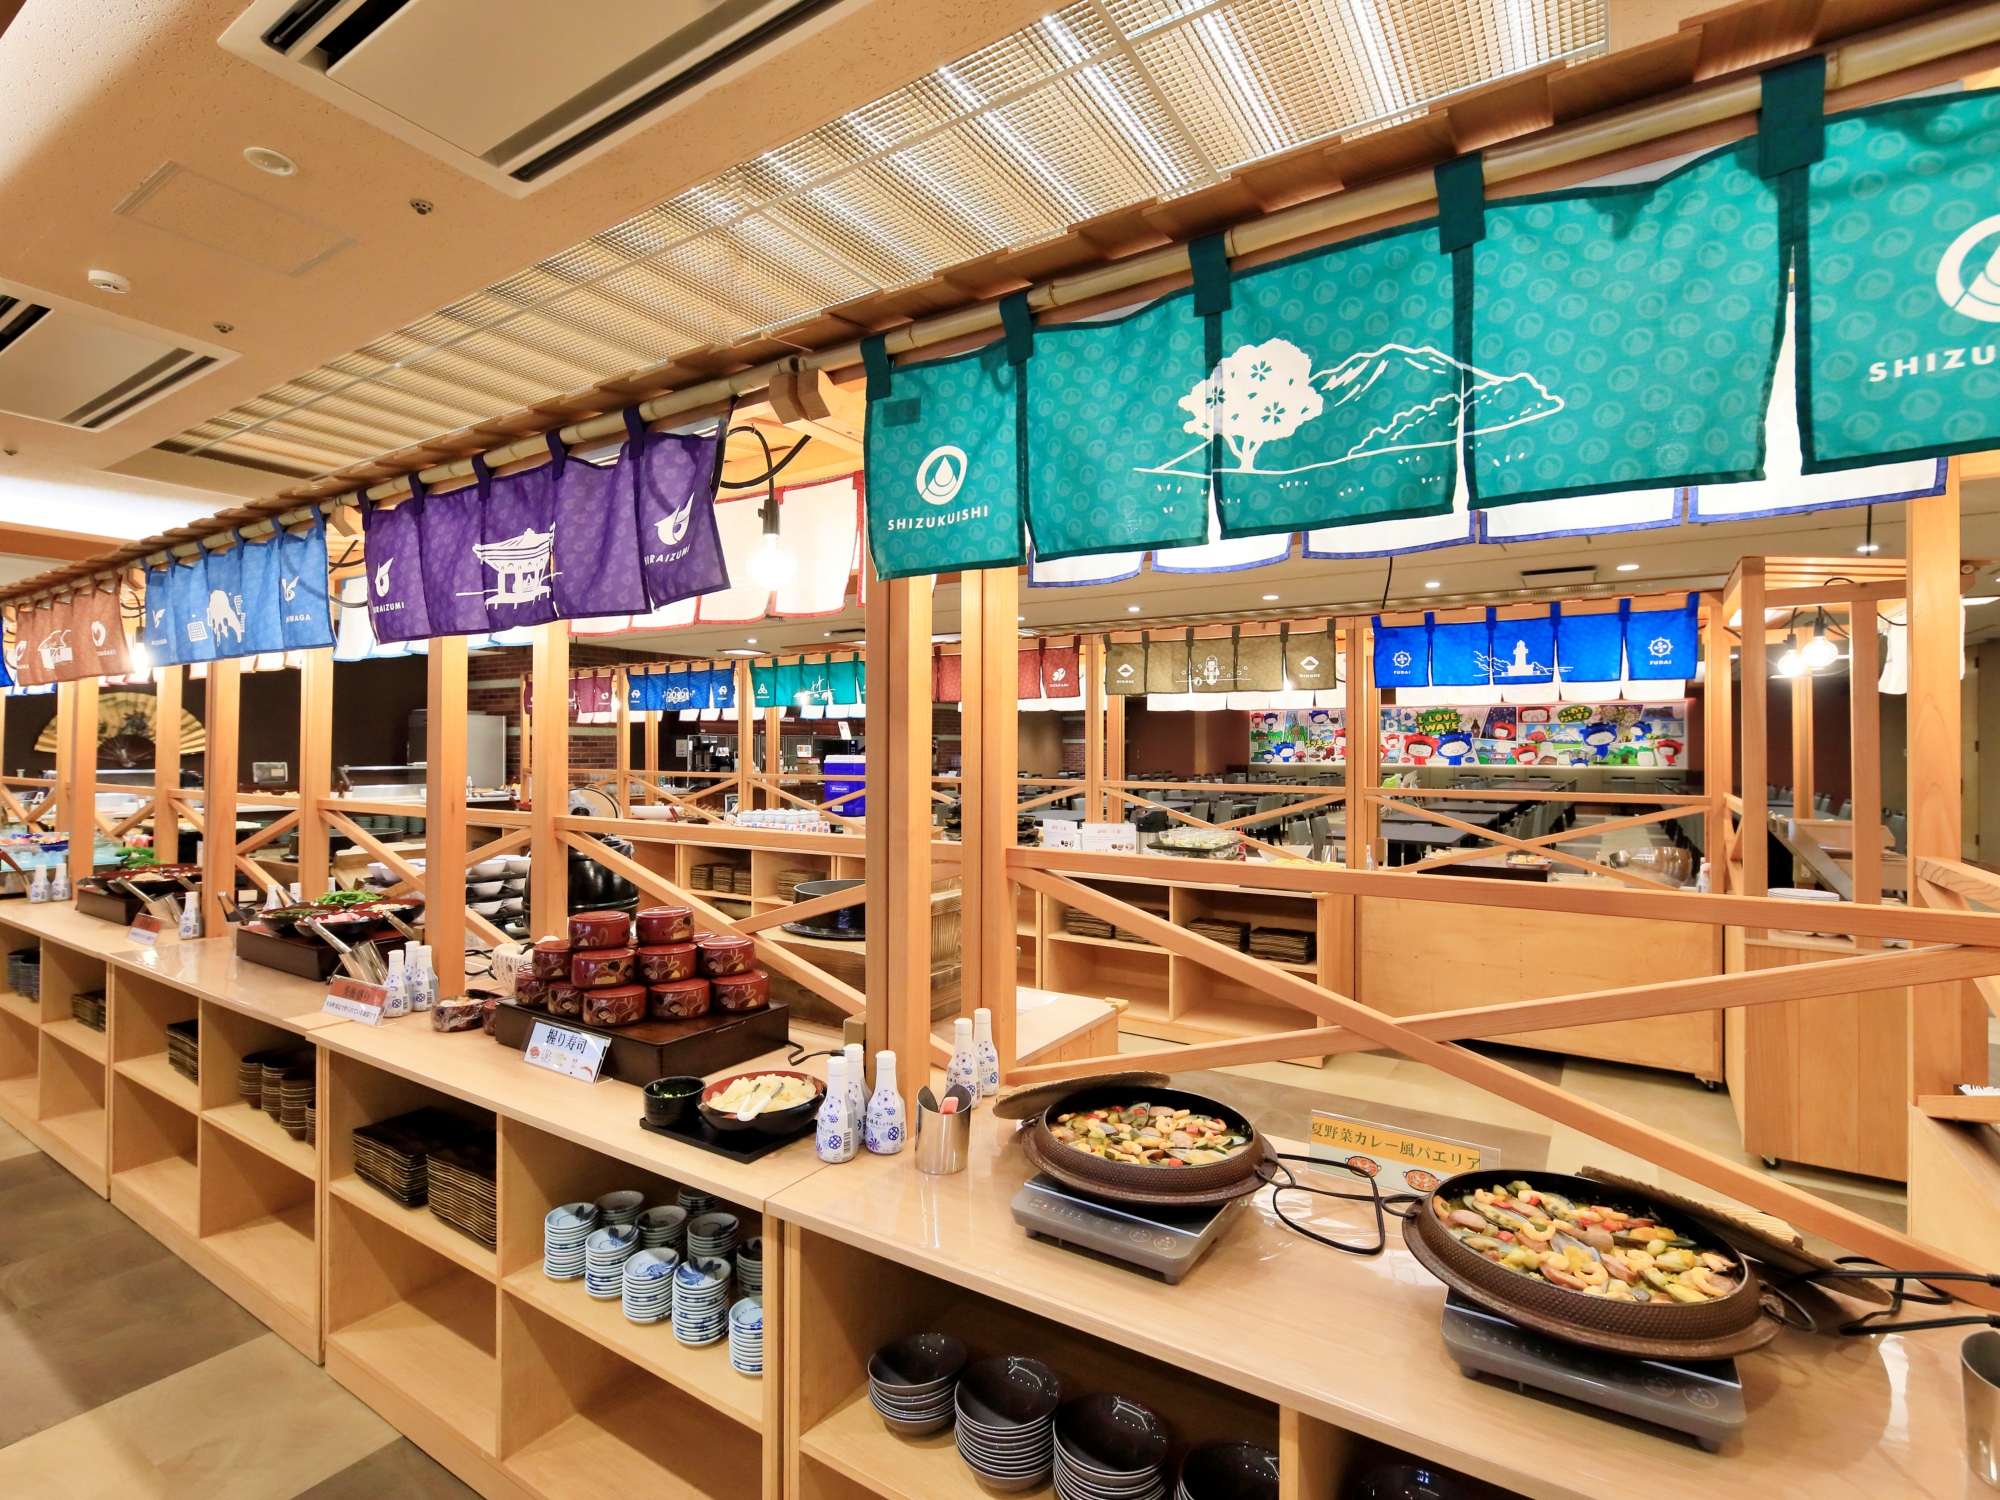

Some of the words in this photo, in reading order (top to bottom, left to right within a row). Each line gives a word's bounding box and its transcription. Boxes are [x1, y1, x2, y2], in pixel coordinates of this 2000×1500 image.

[1868, 344, 1996, 383] SHIZU
[887, 505, 989, 531] SHIZUKUISHI
[1417, 716, 1424, 724] I
[1428, 712, 1458, 723] LOVE
[1418, 721, 1459, 733] IWATE
[545, 1028, 588, 1055] 握り寿司
[1311, 1122, 1481, 1171] 夏野菜カレー風パエリア
